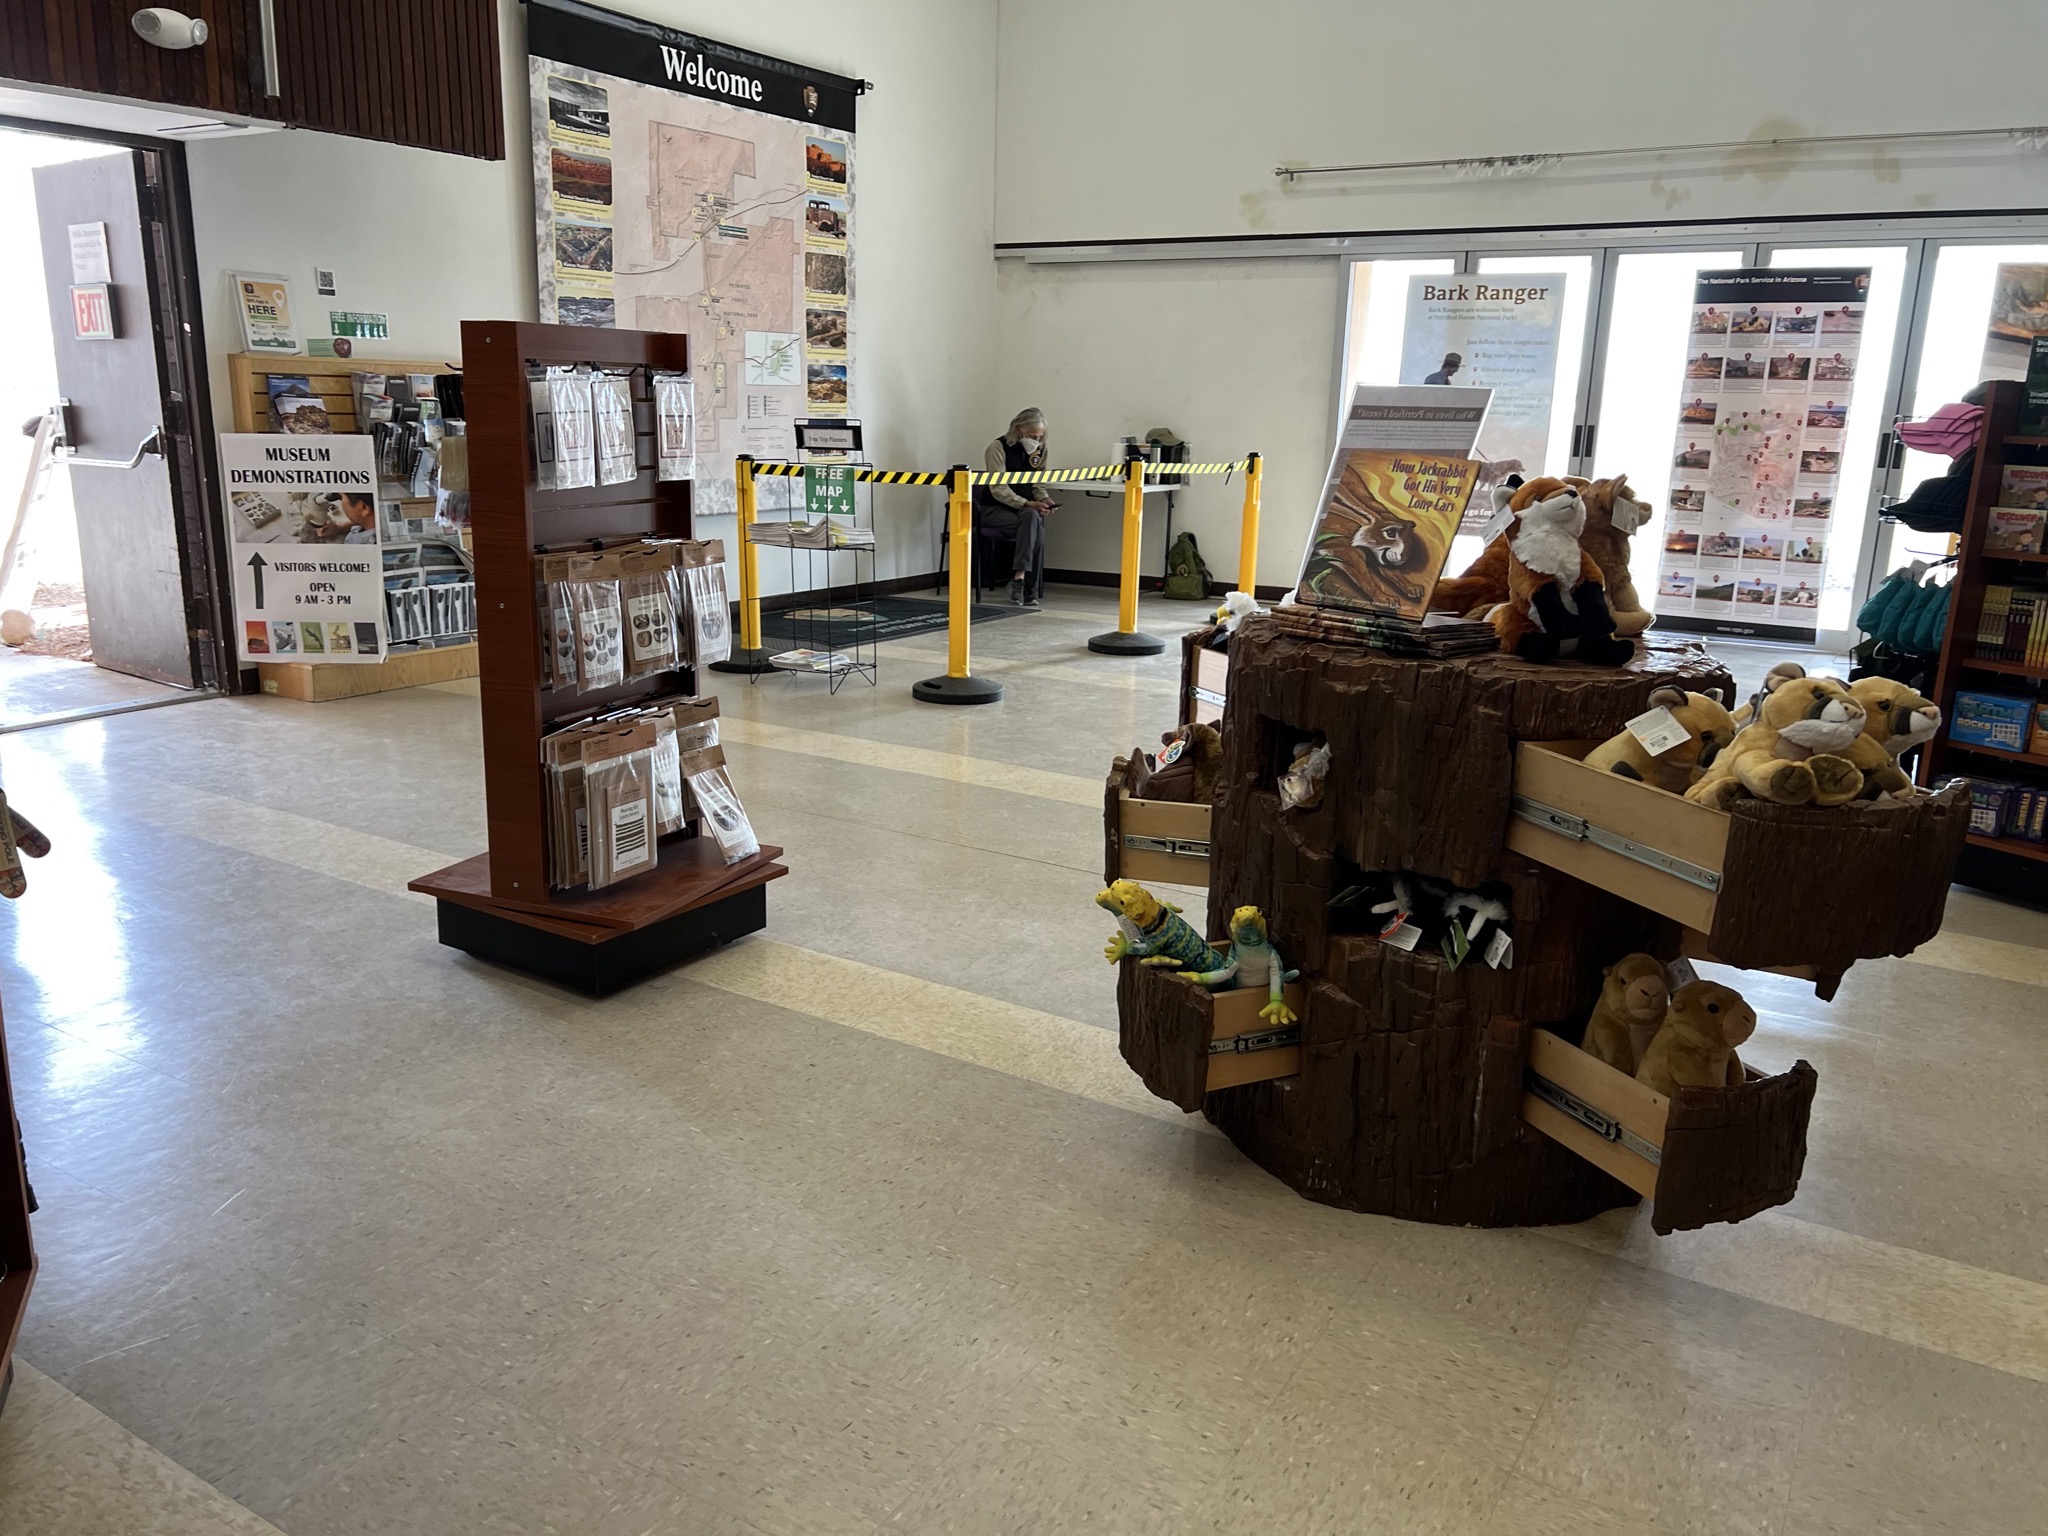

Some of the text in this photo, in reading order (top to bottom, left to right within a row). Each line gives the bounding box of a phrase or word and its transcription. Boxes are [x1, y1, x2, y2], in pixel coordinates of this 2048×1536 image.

[660, 45, 763, 102] Welcome
[1423, 285, 1549, 305] Bark Ranger
[77, 294, 105, 333] EXIT
[248, 305, 278, 316] HERE
[331, 313, 386, 325] FREE INFORMATION
[266, 448, 331, 462] MUSEUM
[816, 468, 844, 480] FREE
[1392, 459, 1469, 479] How Jackrabbit
[231, 470, 370, 485] DEMONSTRATIONS
[816, 485, 843, 497] MAP
[1404, 477, 1462, 499] Got His Very
[1408, 495, 1455, 513] Long Ears
[275, 562, 371, 573] VISITORS WELCOME!
[309, 583, 336, 592] OPEN
[295, 595, 302, 605] 9
[304, 595, 318, 605] AM
[327, 595, 334, 605] 3
[337, 595, 352, 605] PM
[1957, 717, 1991, 730] ROCKS
[3, 842, 15, 864] POLE
